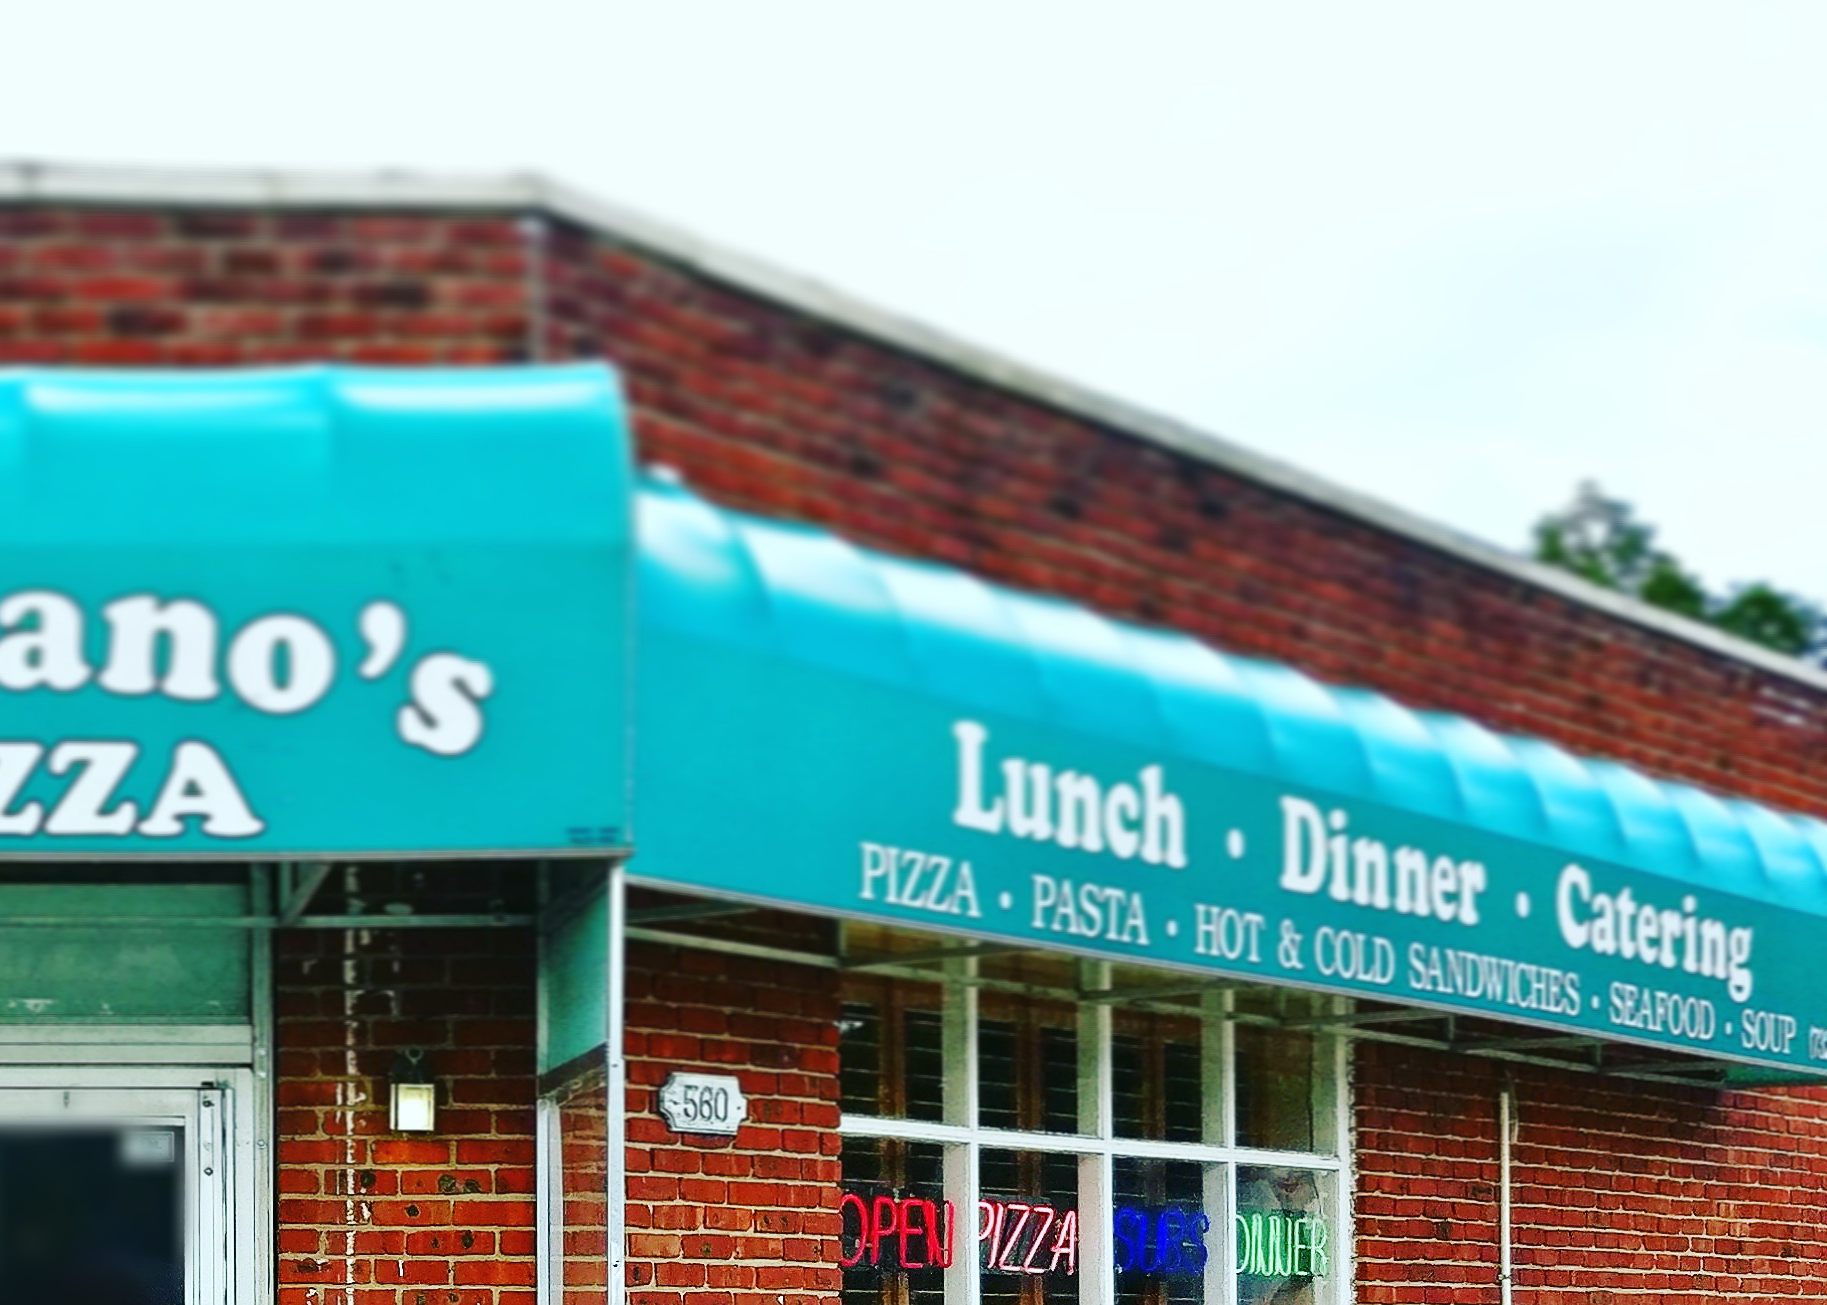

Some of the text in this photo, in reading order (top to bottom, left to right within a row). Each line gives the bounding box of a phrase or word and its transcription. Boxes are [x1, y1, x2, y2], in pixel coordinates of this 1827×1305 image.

[953, 721, 1753, 1003] Lunch Dinner Catering
[859, 842, 982, 918] PIZZA
[1031, 874, 1150, 945] PASTA
[1194, 903, 1265, 963] HOT
[1277, 919, 1304, 969] &
[1315, 925, 1395, 985] COLD
[1409, 942, 1580, 1017] SANDWICHES
[1610, 981, 1715, 1041] SEAFOOD
[1742, 1009, 1797, 1054] SOUP
[683, 1084, 729, 1123] 560
[841, 1193, 956, 1269] OPEN
[978, 1198, 1078, 1276] PIZZA
[1236, 1213, 1328, 1278] DINNER
